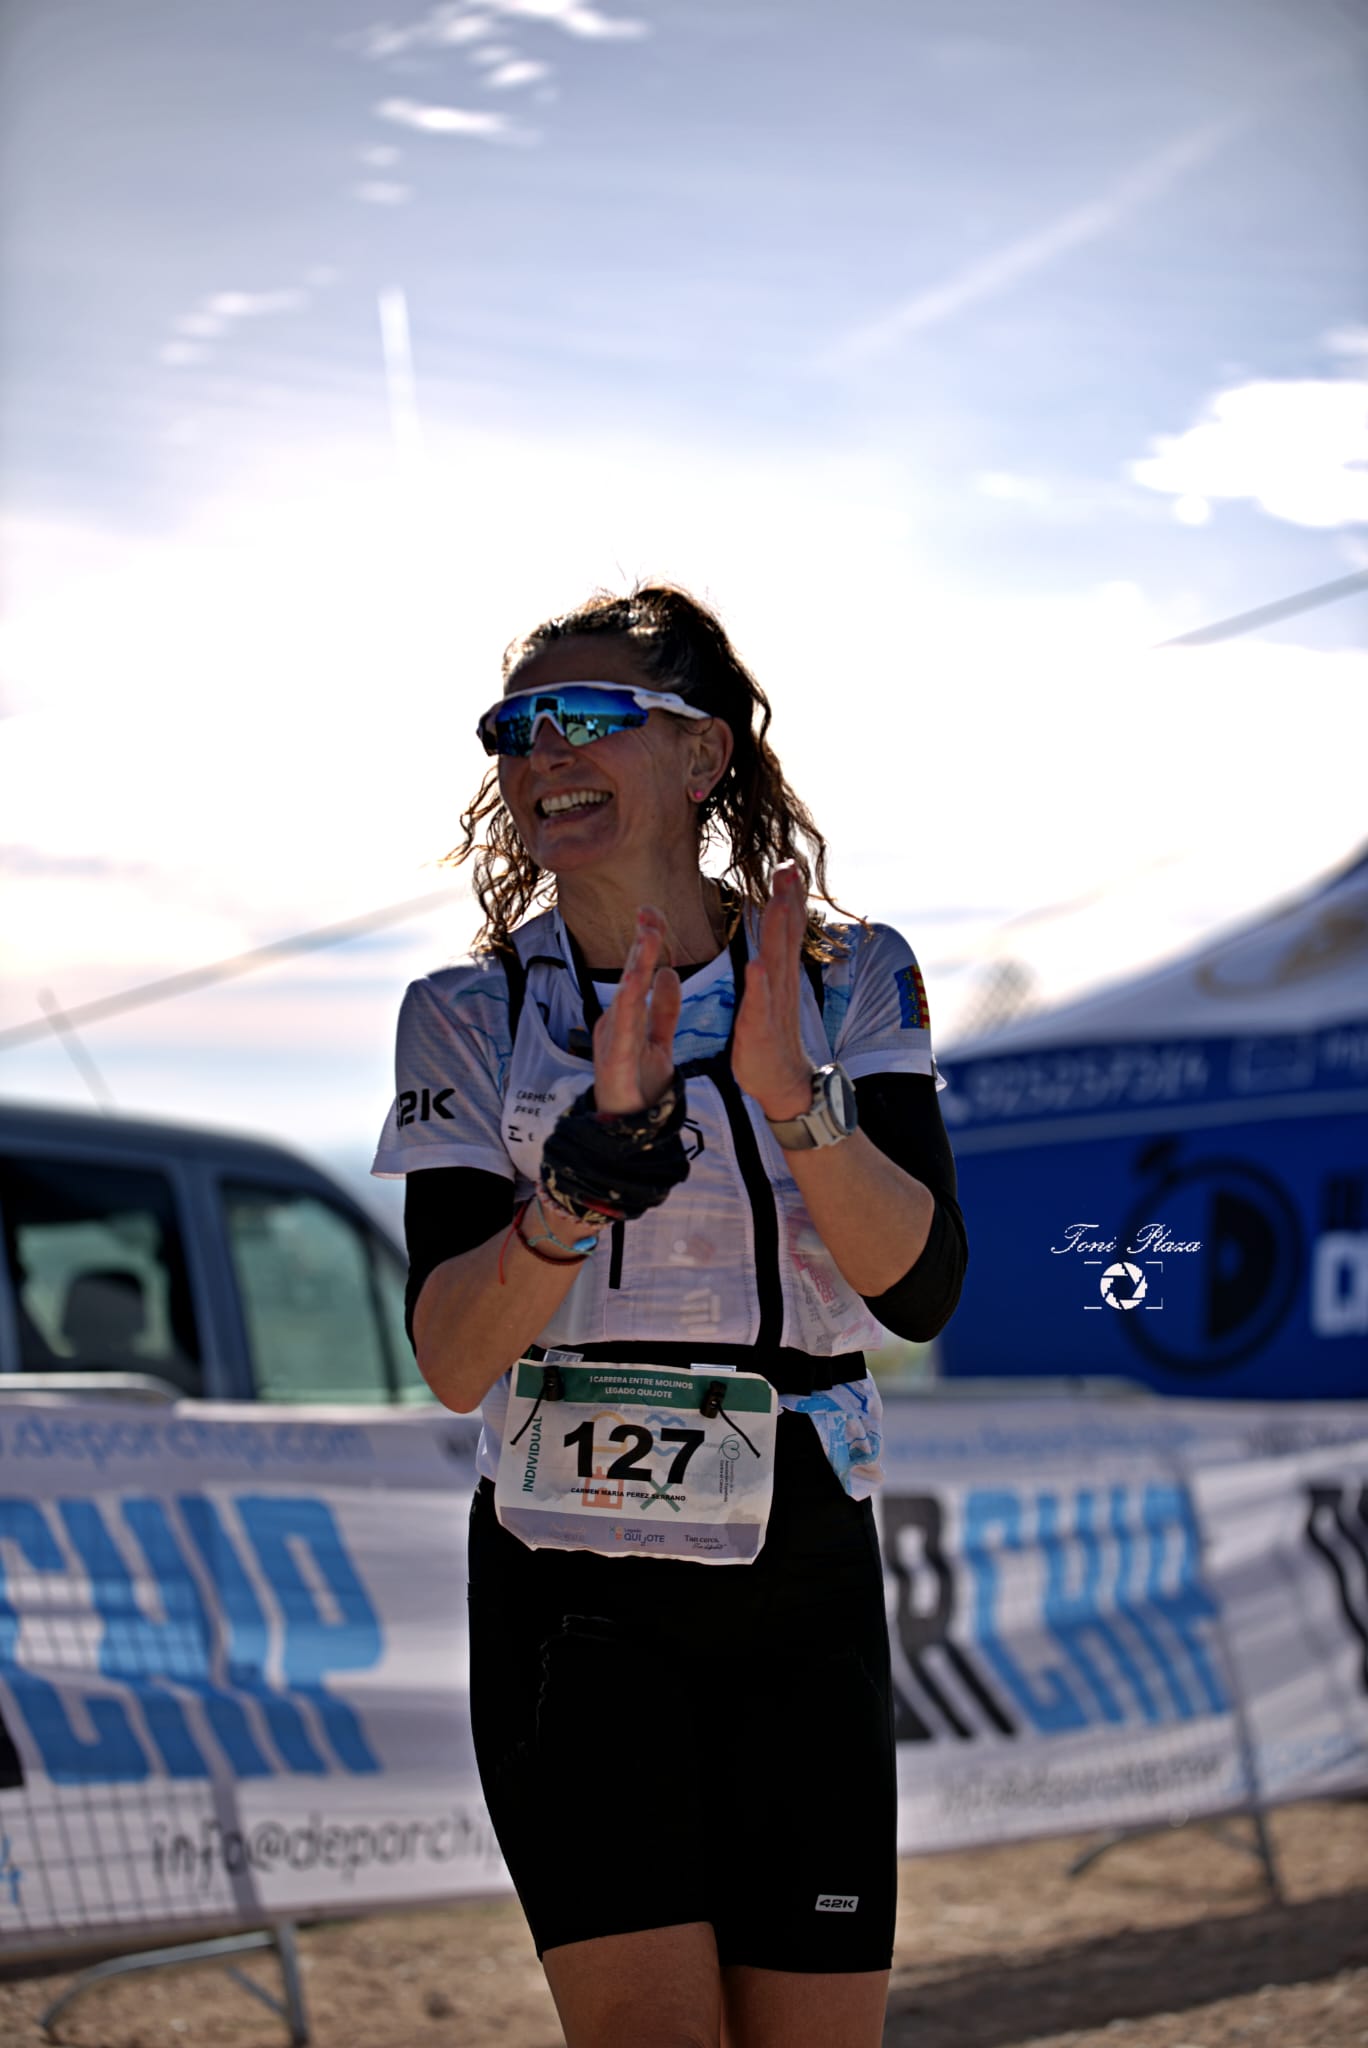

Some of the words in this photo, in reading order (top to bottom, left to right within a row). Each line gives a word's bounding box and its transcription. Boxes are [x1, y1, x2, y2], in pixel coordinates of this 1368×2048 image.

[516, 1090, 557, 1103] CARMEN
[396, 1088, 456, 1131] 2K
[594, 1376, 627, 1384] CARRERA
[629, 1377, 653, 1386] ENTRE
[655, 1379, 694, 1390] MOLINOS
[605, 1387, 636, 1395] LEGADO
[637, 1389, 673, 1399] QUIJOTE
[522, 1416, 543, 1493] INDIVIDUAL
[563, 1421, 705, 1484] 127
[570, 1487, 599, 1495] CARMEN
[601, 1489, 624, 1497] MARIA
[626, 1491, 649, 1499] PEREZ
[651, 1493, 686, 1501] SERRANO
[819, 1898, 855, 1909] 42K
